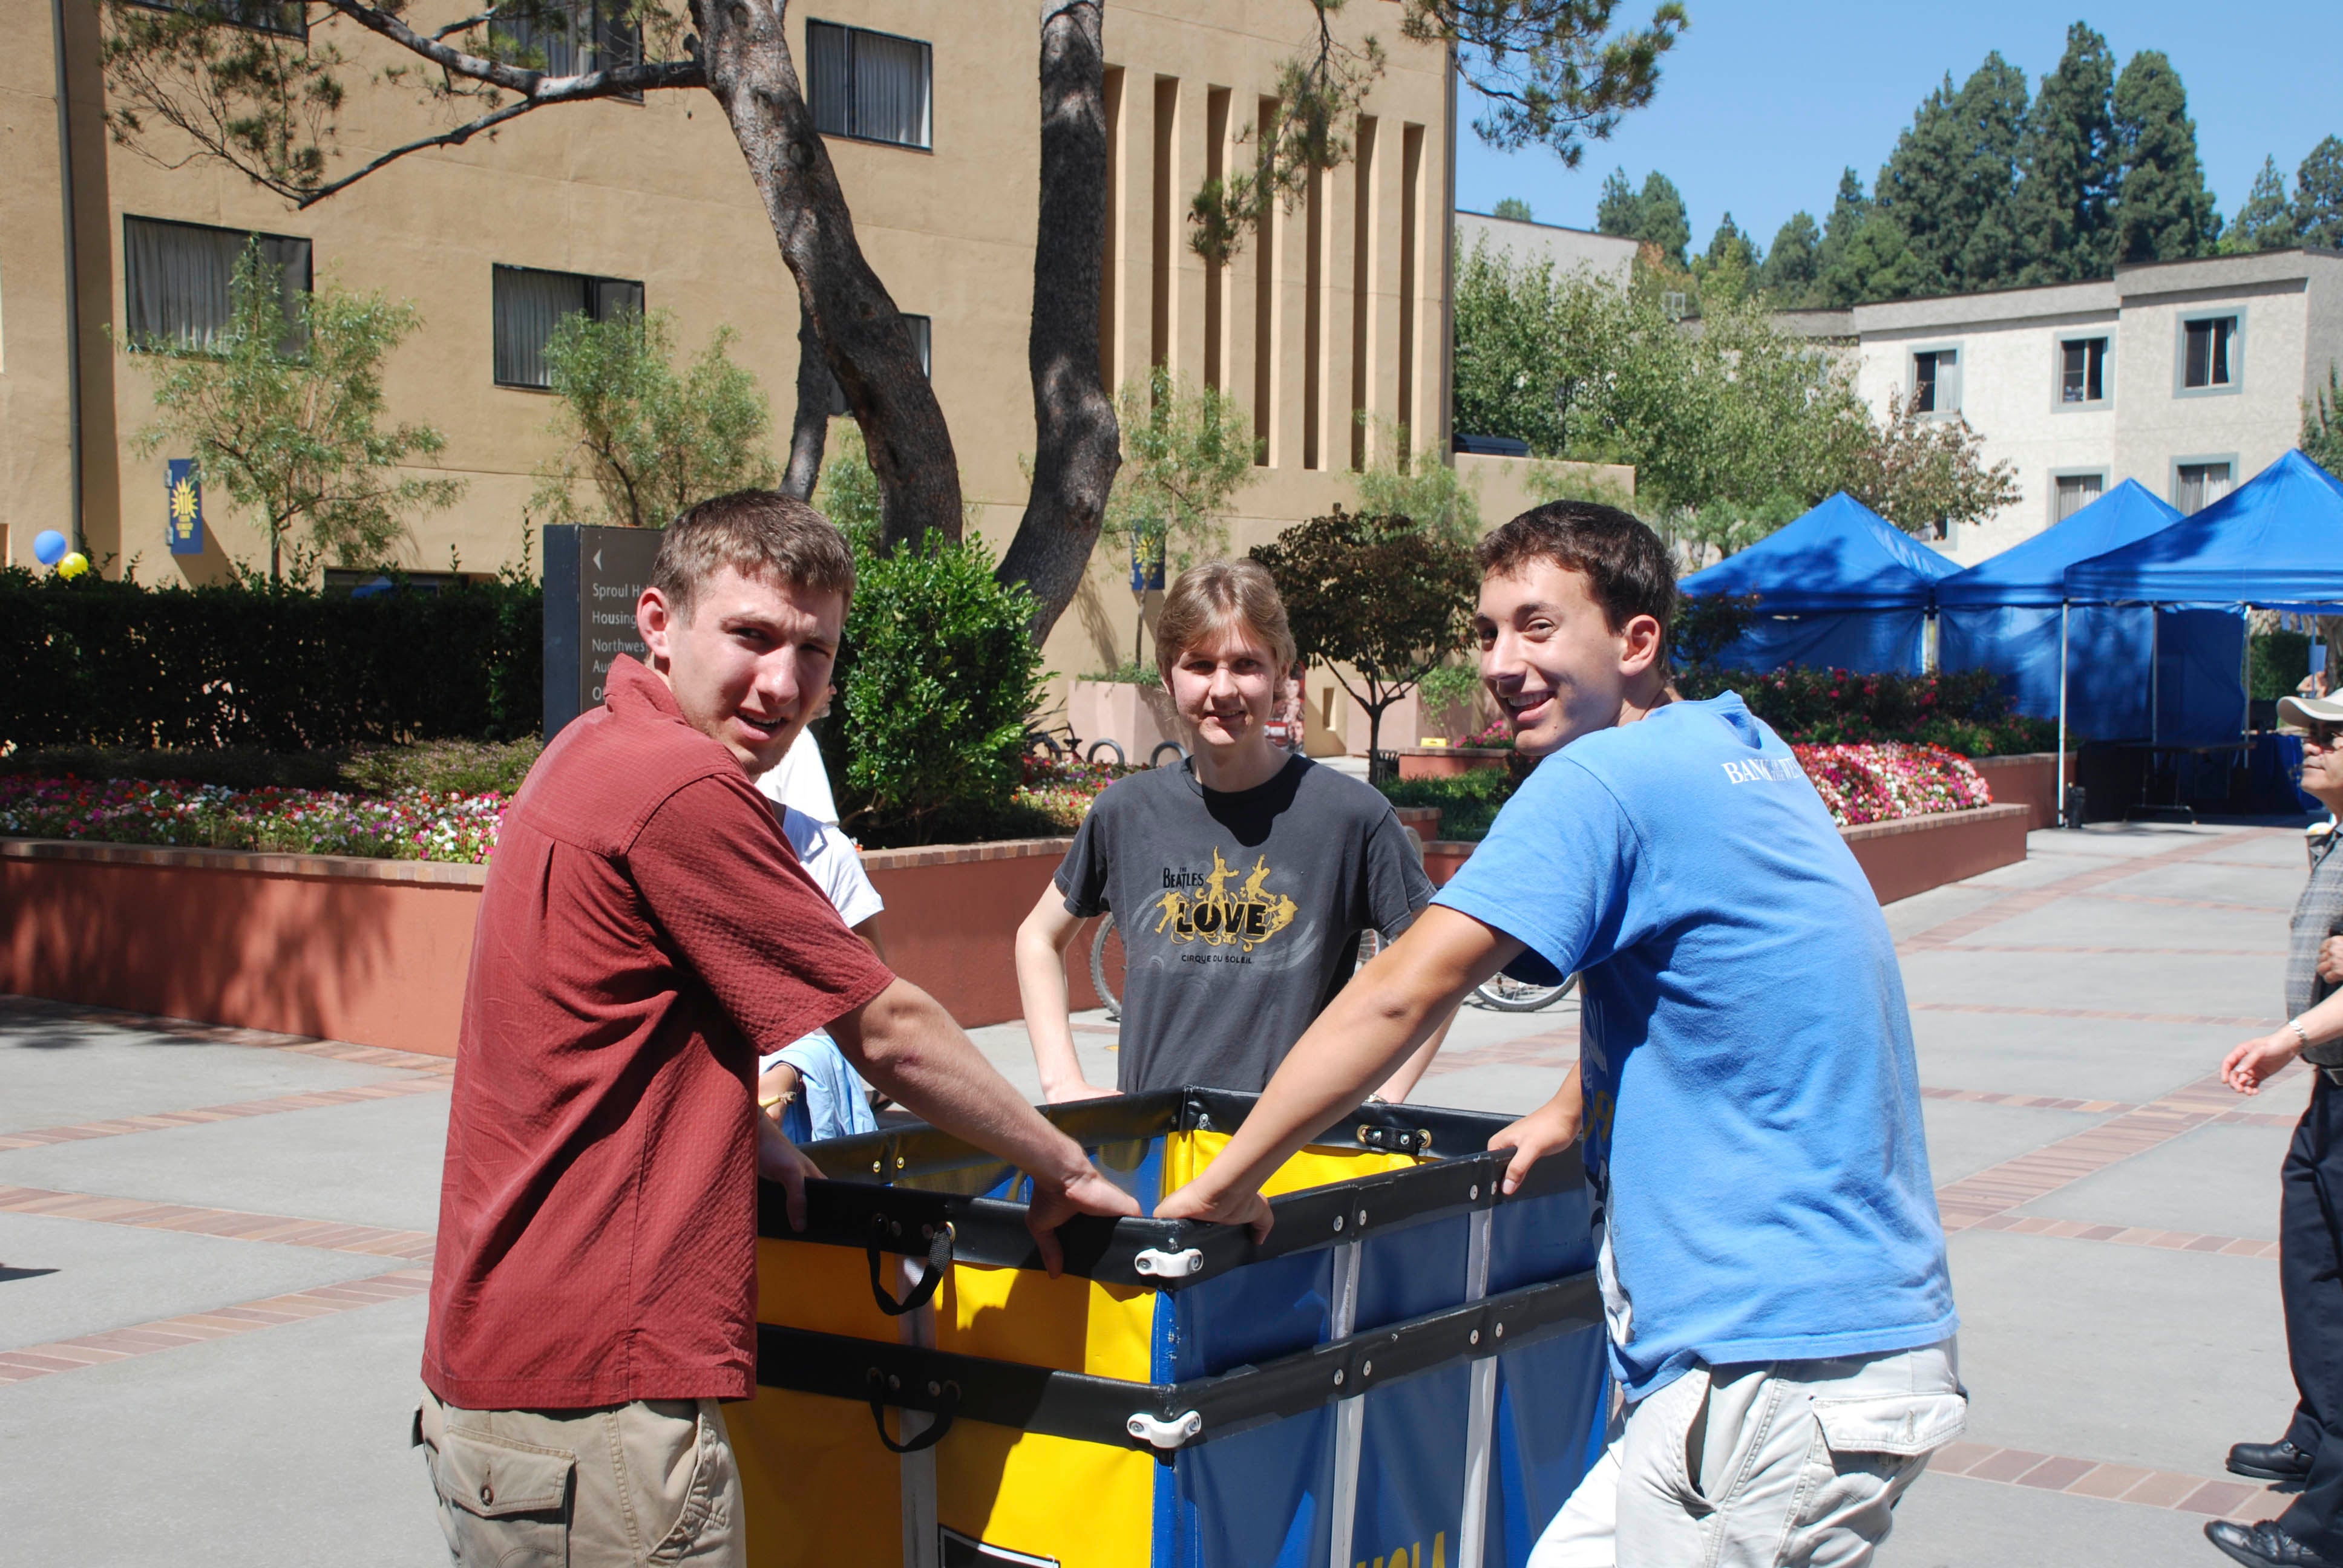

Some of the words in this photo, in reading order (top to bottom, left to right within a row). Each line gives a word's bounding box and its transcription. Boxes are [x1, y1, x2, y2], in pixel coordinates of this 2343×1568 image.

[592, 583, 628, 601] Sproul
[592, 611, 637, 629] Housing
[592, 638, 648, 653] Northwes
[1721, 759, 1772, 784] BANK
[1163, 867, 1204, 889] BEATLES
[1176, 903, 1267, 935] LOVE
[1181, 954, 1211, 964] CIRQUE
[1225, 955, 1253, 964] SOLEIL
